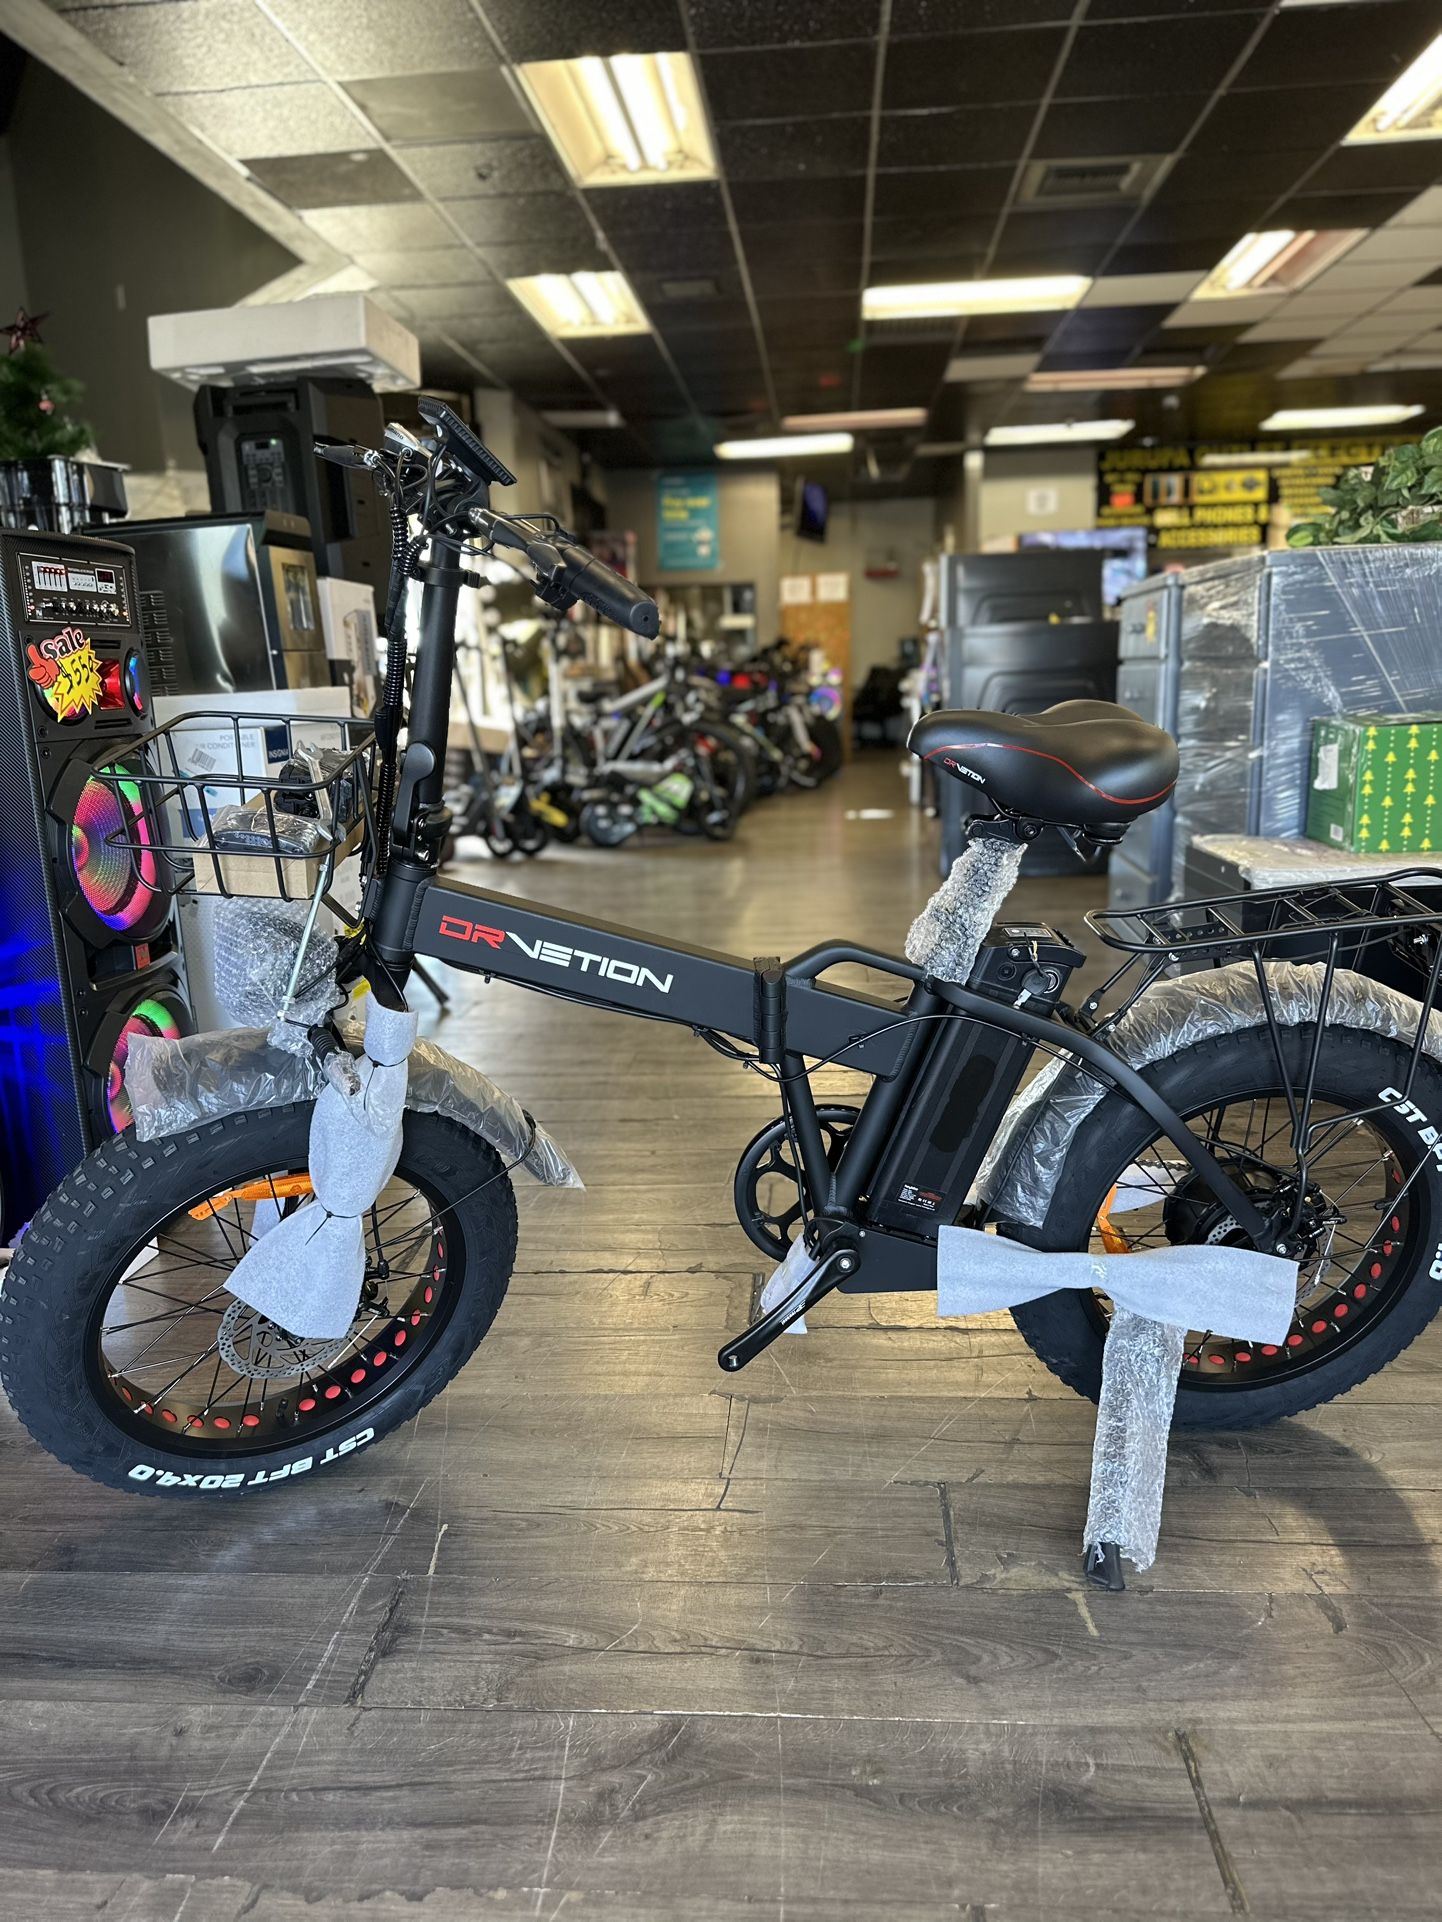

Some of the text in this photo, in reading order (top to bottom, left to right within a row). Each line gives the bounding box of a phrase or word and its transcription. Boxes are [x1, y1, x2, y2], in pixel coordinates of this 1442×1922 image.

[42, 629, 85, 659] Sale
[943, 757, 986, 784] DRVETION
[438, 915, 674, 994] DRVETION
[320, 1427, 375, 1465] CST
[246, 1456, 313, 1486] BFT
